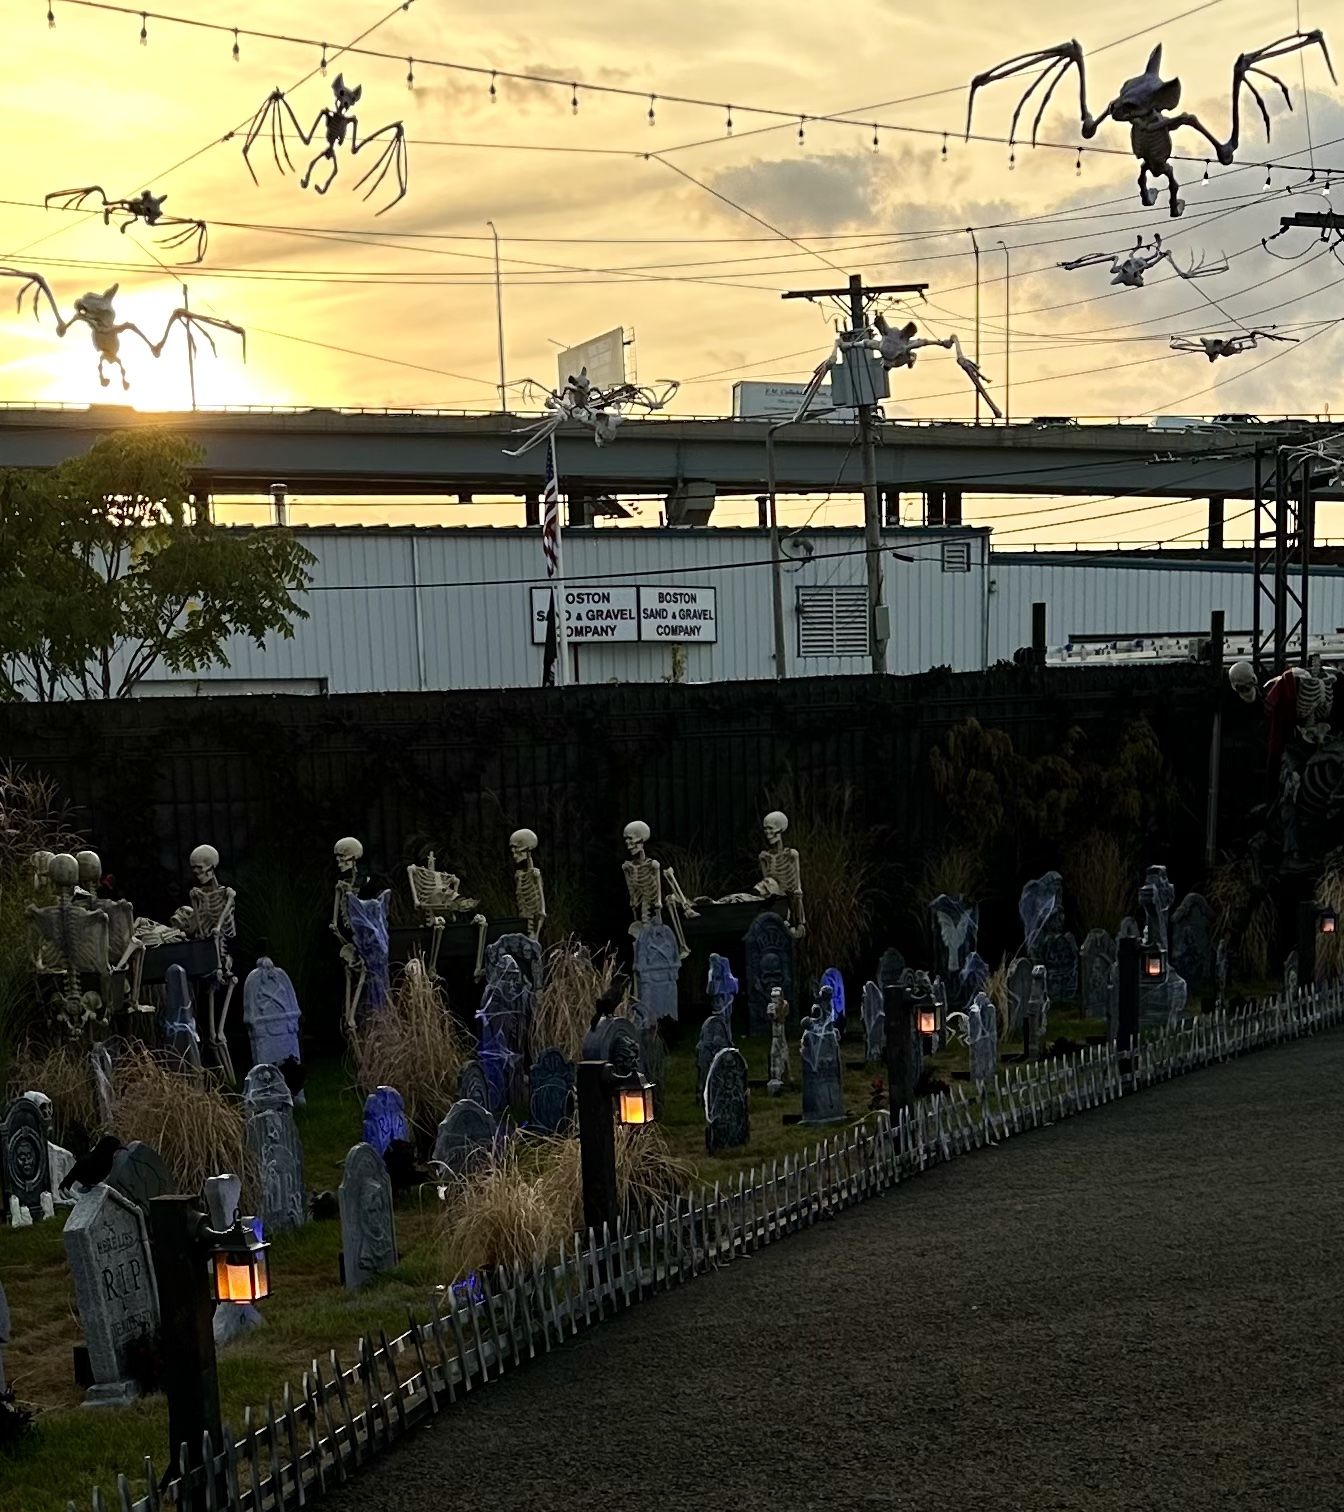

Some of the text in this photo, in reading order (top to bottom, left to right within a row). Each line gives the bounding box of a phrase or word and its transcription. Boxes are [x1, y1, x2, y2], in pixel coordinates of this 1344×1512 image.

[564, 592, 611, 604] OSTON
[658, 592, 697, 604] BOSTON
[585, 608, 636, 621] GRAVEL
[642, 607, 668, 620] SAND
[678, 609, 714, 621] GRAVEL
[565, 625, 617, 637] OMPANY
[656, 624, 702, 637] COMPANY
[101, 1259, 141, 1301] RIP
